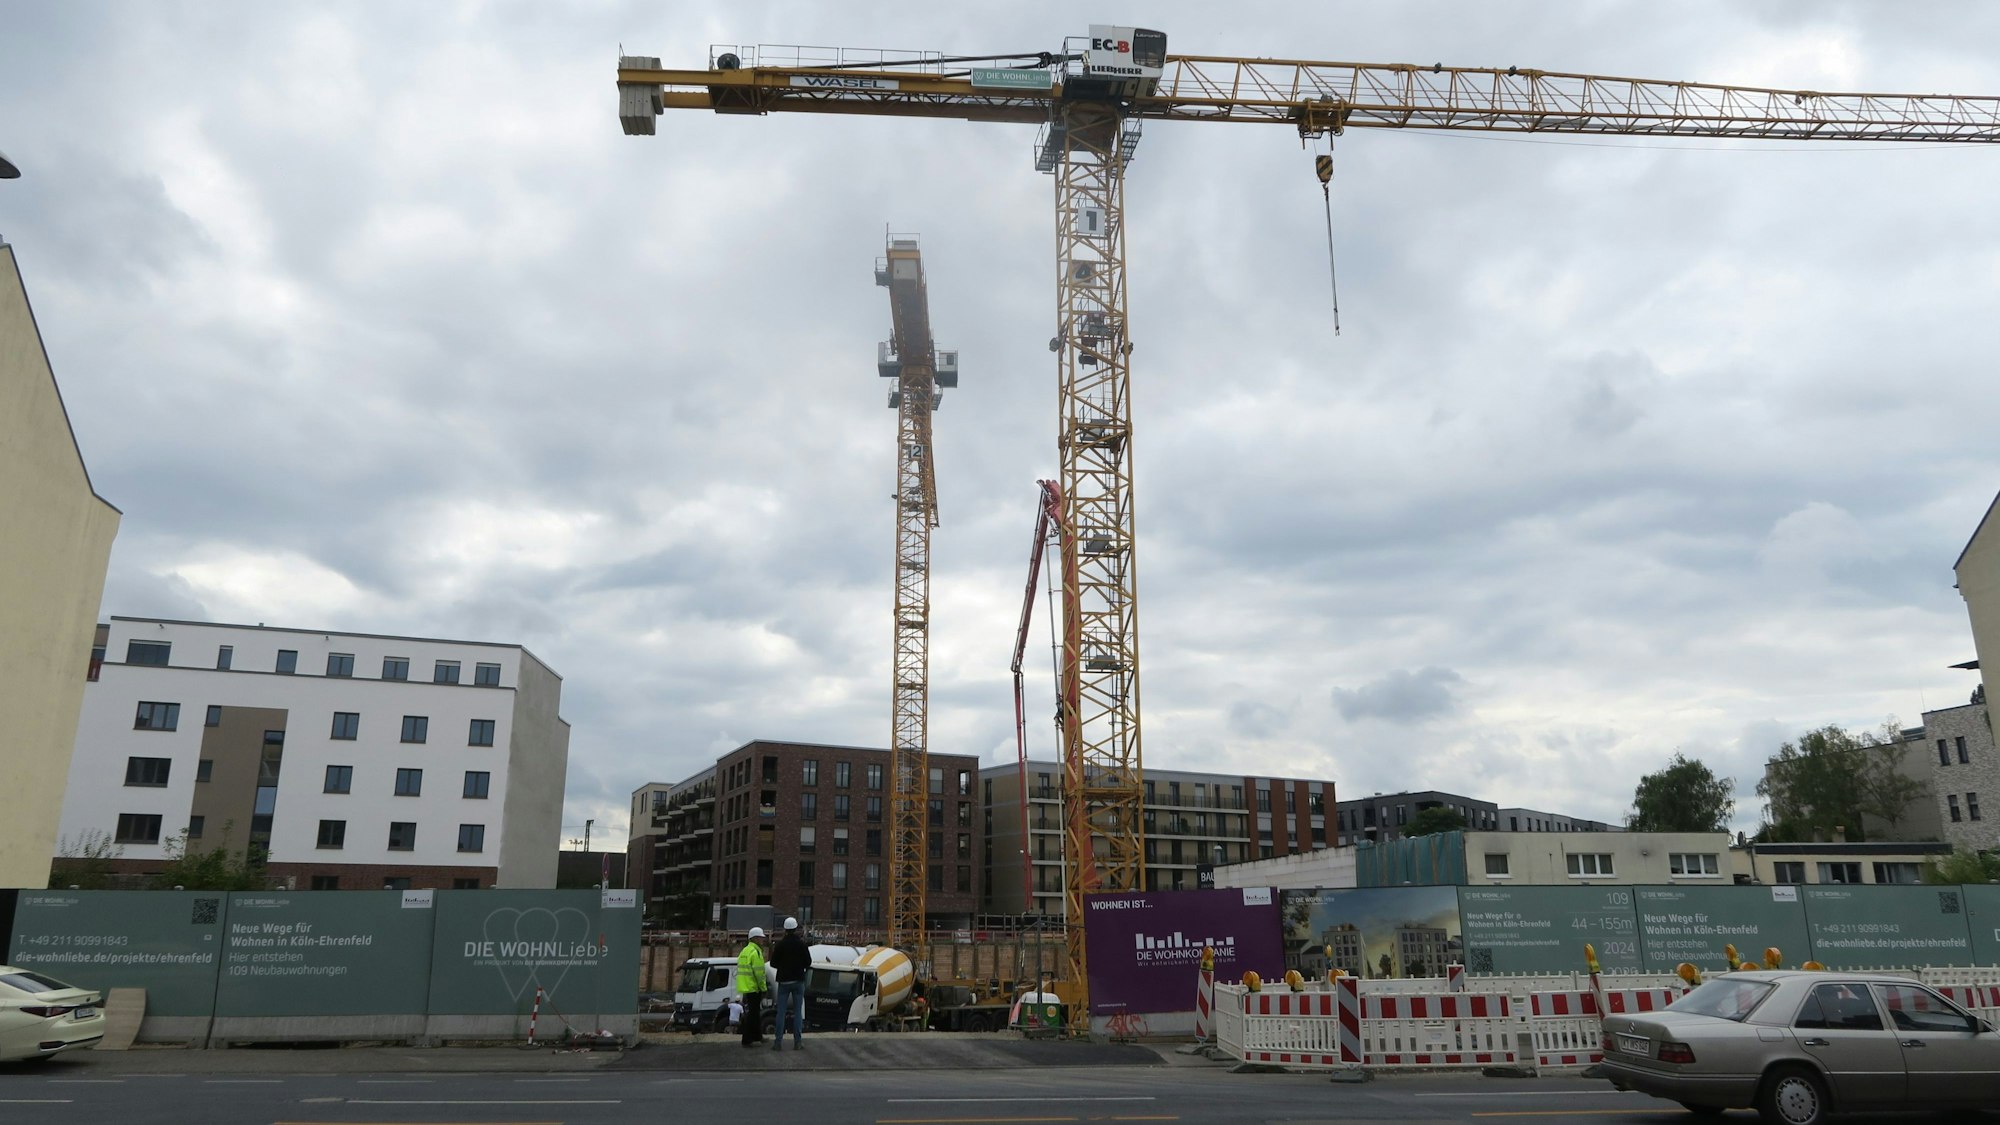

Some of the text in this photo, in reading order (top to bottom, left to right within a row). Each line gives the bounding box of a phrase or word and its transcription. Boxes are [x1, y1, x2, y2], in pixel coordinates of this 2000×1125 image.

[1092, 38, 1130, 53] EC-B
[1091, 65, 1142, 75] LIEBHERR
[986, 71, 1050, 82] DIE WOHNLiebe
[805, 77, 886, 89] WASEL
[1086, 210, 1097, 232] 1
[912, 445, 922, 457] 2
[1606, 892, 1629, 905] 109
[1091, 900, 1130, 910] WOHNEN
[1467, 911, 1515, 921] Neue Wege für
[1644, 912, 1709, 924] Neue Wege für
[232, 921, 312, 935] Neue Wege für
[1503, 920, 1551, 928] Köln-Ehrenfeld
[1571, 918, 1587, 929] 44
[1822, 924, 1839, 933] +49
[1841, 924, 1856, 933] 211
[1857, 924, 1900, 933] 90991843
[1645, 924, 1759, 935] Wohnen in Köln-Ehrenfeld
[29, 935, 50, 946] +49
[51, 935, 72, 946] 211
[74, 935, 128, 946] 90991843
[231, 934, 372, 947] Wohnen in Köln-Ehrenfeld
[1647, 939, 1708, 949] Hier entstehen
[1816, 938, 1967, 949] die-wohnliebe.de/projekte/ehrenfeld
[463, 941, 608, 958] DIE WOHNLiebe
[1603, 941, 1635, 954] 2024
[15, 951, 213, 965] die-wohnliebe.de/projekte/ehrenfeld
[229, 951, 304, 962] Hier entstehen
[1136, 947, 1236, 961] DIE WOHNKOANIE
[1650, 951, 1666, 960] 109
[229, 964, 348, 977] 109 Neubauwohnungen
